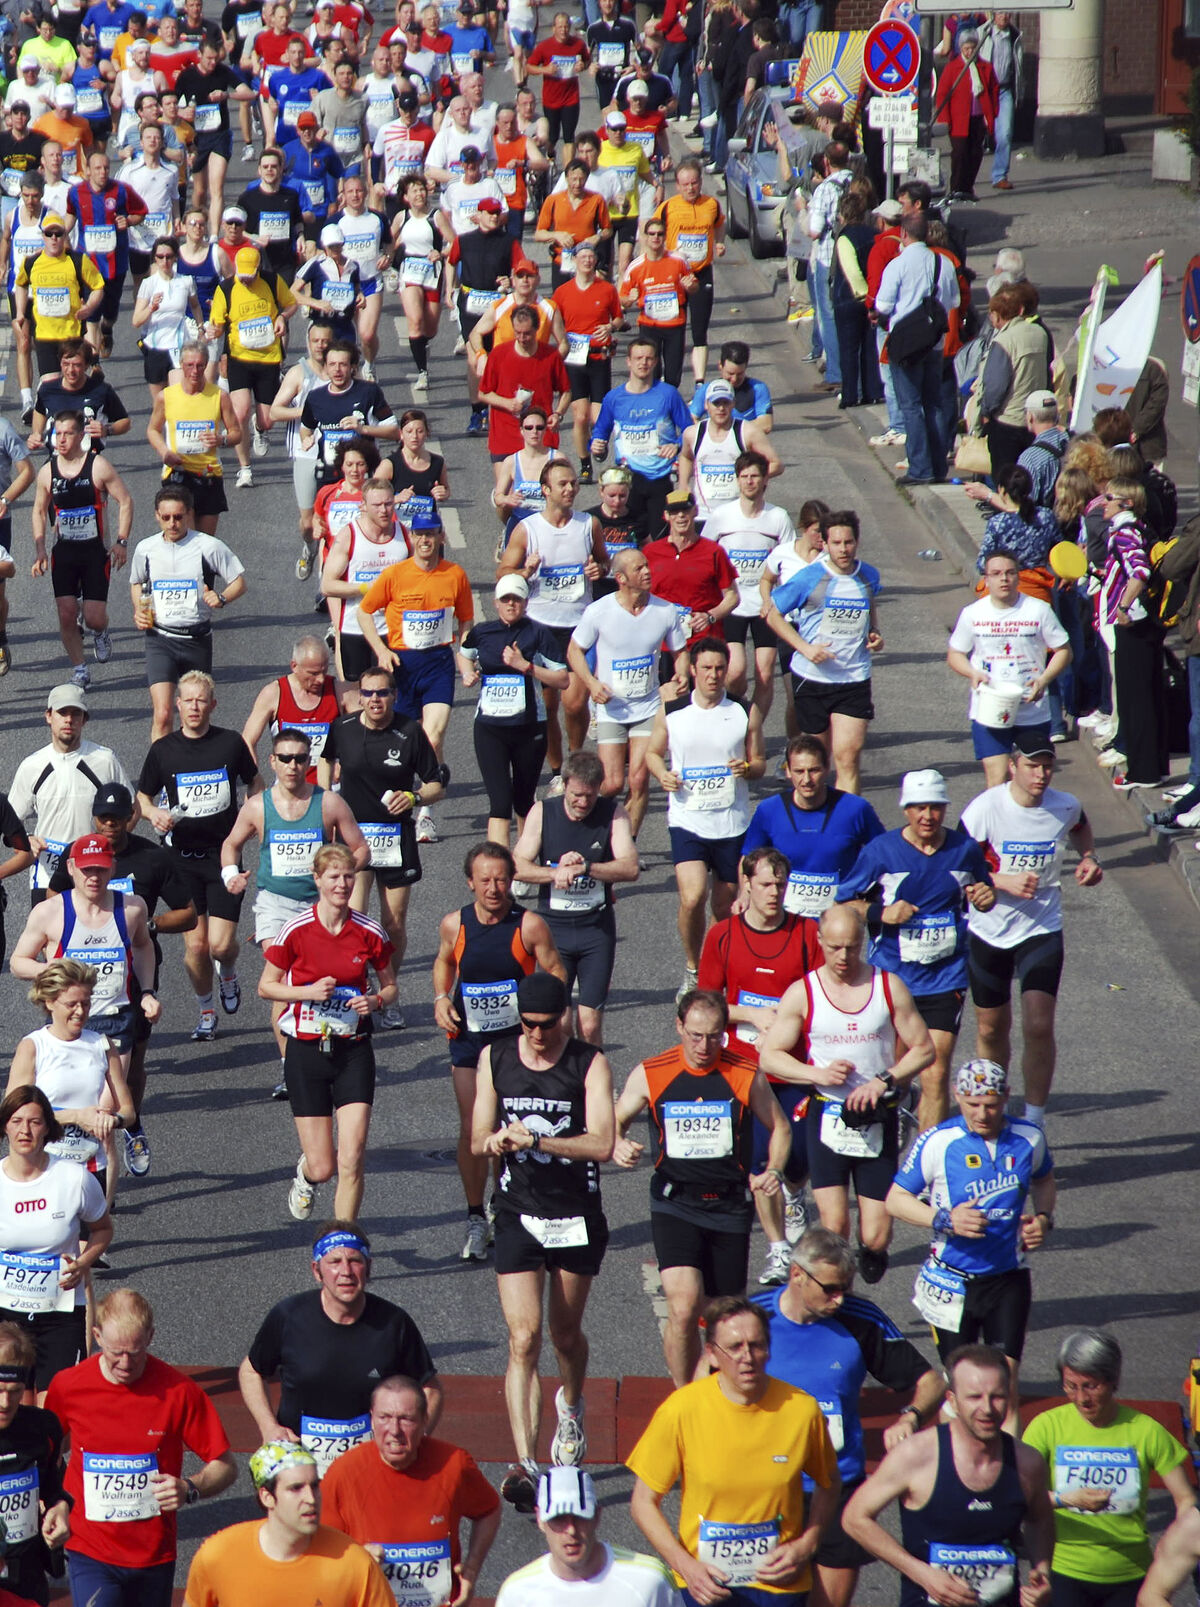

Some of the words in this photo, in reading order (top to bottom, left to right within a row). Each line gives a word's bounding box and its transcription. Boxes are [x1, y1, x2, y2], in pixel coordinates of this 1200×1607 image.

[706, 473, 734, 482] 8745
[61, 515, 90, 526] 3816
[362, 560, 400, 568] DANMAR
[733, 560, 764, 569] 2047
[156, 581, 193, 589] CONERGY
[546, 577, 576, 586] 5368
[159, 590, 188, 601] 1251
[829, 609, 861, 620] 3243
[409, 620, 439, 631] 5398
[615, 658, 652, 669] CONERGY
[618, 668, 650, 680] 11754
[486, 687, 518, 697] F4049
[181, 771, 224, 783] CONERGY
[686, 768, 729, 777] CONERGY
[690, 776, 725, 790] 7362
[185, 783, 220, 798] 7021
[274, 833, 317, 841] CONERGY
[277, 843, 312, 855] 9551
[1010, 854, 1044, 867] 1531
[789, 873, 834, 882] CONERGY
[792, 884, 831, 897] 12349
[907, 929, 947, 941] 14131
[71, 950, 119, 960] CONERGY
[467, 983, 512, 995] CONERGY
[471, 995, 510, 1011] 9332
[744, 996, 781, 1005] CONER
[824, 1033, 883, 1045] DANMARK
[671, 1104, 724, 1115] CONERGY
[674, 1118, 721, 1132] 19342
[678, 1132, 719, 1140] Alexander
[964, 1173, 1020, 1200] Italia
[15, 1198, 46, 1214] OTTO
[2, 1253, 55, 1266] CONERGY
[3, 1267, 50, 1284] F977
[5, 1282, 47, 1293] Madeleine
[20, 1300, 41, 1309] asics
[307, 1420, 365, 1433] CONERGY
[1064, 1451, 1130, 1462] CONERGY
[89, 1457, 151, 1468] CONERGY
[93, 1472, 148, 1490] 17549
[1066, 1467, 1127, 1485] F4050
[102, 1490, 142, 1499] Wolfram
[707, 1525, 773, 1537] CONERGY
[709, 1537, 768, 1557] 15238
[938, 1549, 1006, 1560] CONERGY
